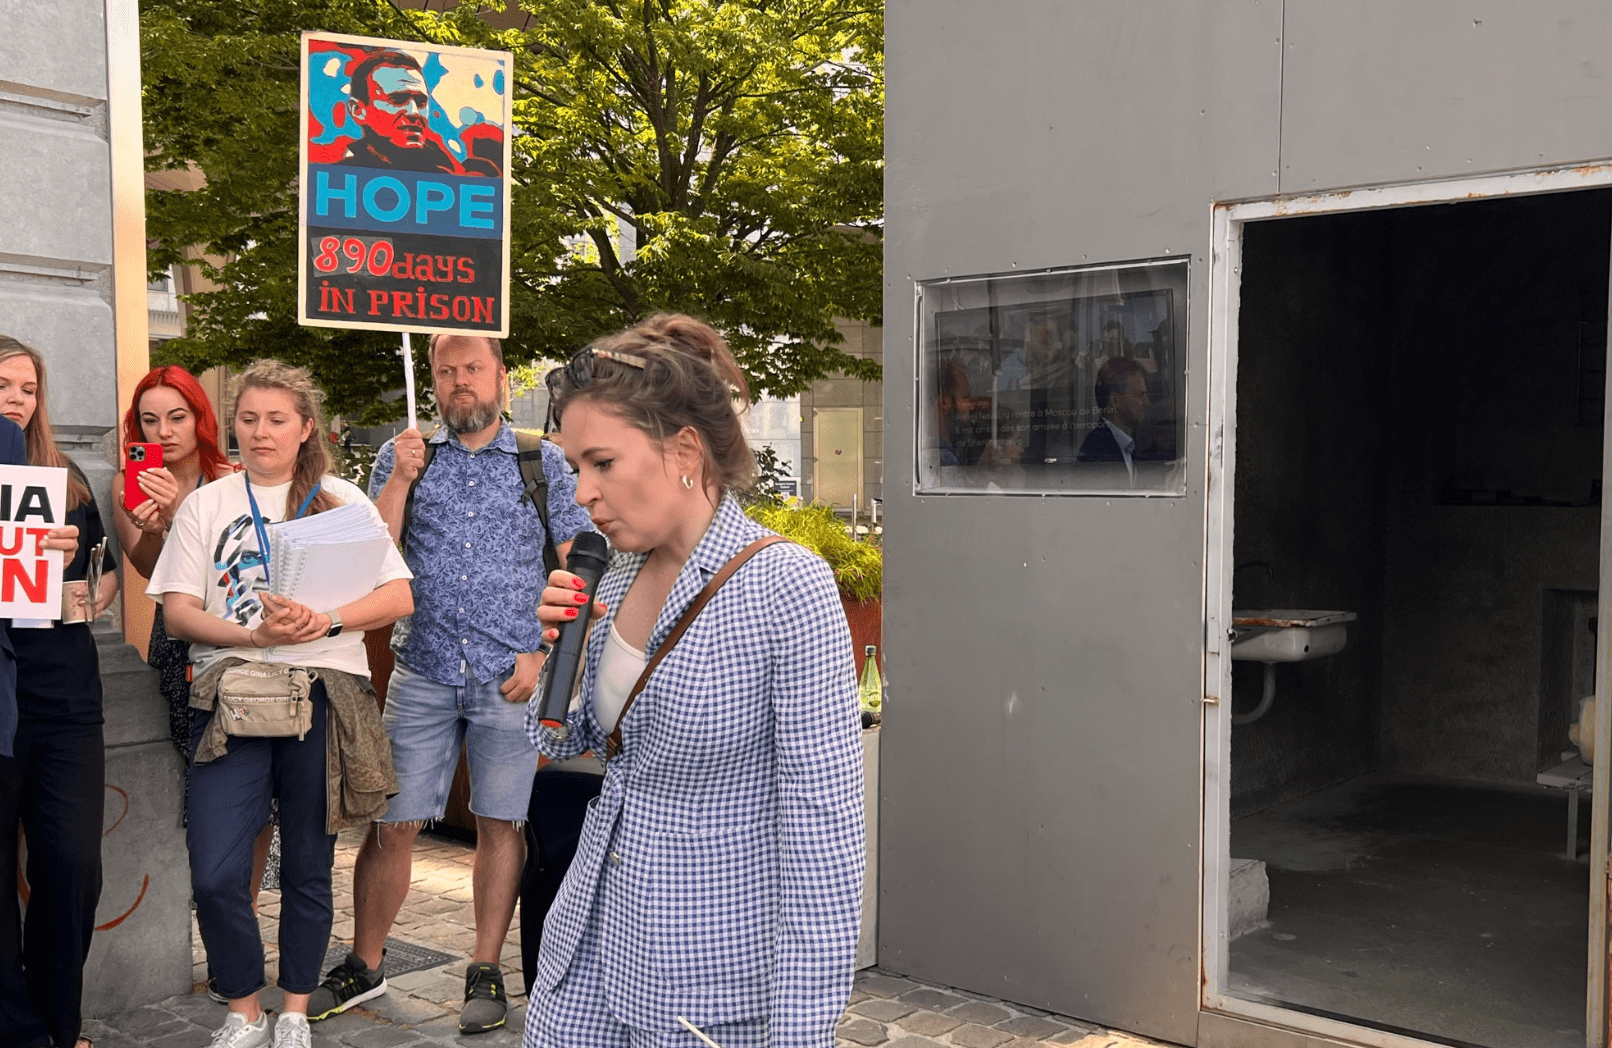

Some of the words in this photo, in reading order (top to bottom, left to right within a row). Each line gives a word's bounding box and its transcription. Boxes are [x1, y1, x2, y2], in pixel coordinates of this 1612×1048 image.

[316, 171, 495, 229] HOPE
[313, 236, 394, 277] 890
[391, 253, 476, 283] days
[1011, 410, 1036, 418] rentre
[1045, 408, 1078, 417] Moscou
[1079, 407, 1090, 415] de
[962, 426, 973, 434] est
[1016, 424, 1030, 432] son
[1, 484, 55, 524] IA
[1, 558, 49, 603] N
[250, 670, 267, 678] GINA
[223, 695, 243, 703] LUCY
